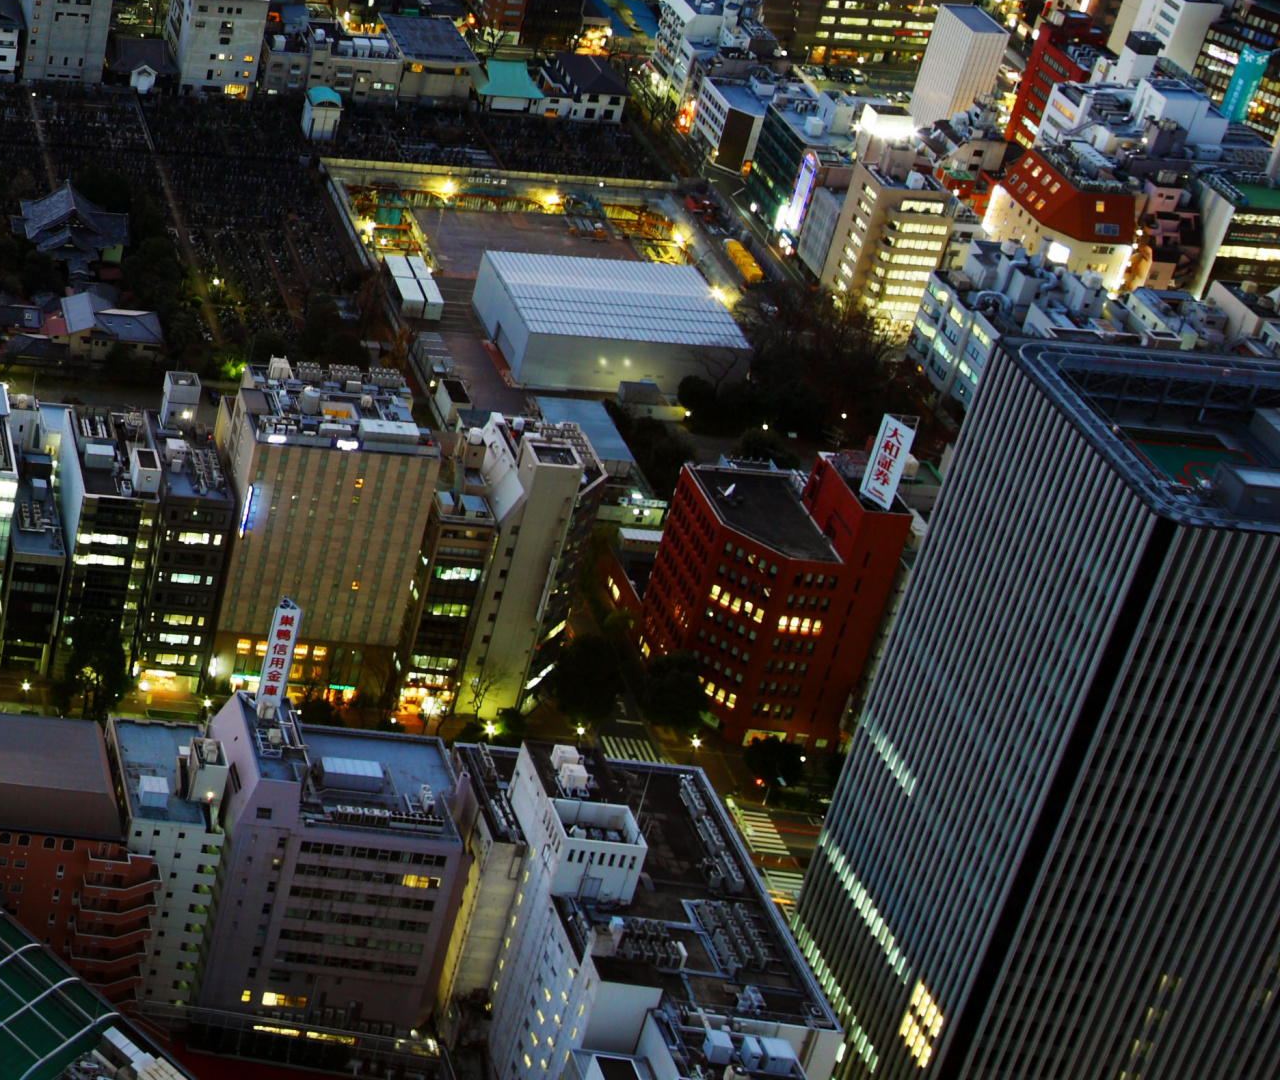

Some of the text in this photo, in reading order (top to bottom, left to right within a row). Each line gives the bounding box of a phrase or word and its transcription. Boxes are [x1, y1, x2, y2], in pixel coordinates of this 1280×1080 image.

[872, 427, 905, 487] 大和証券
[262, 615, 295, 696] 巣鴨信用金庫
